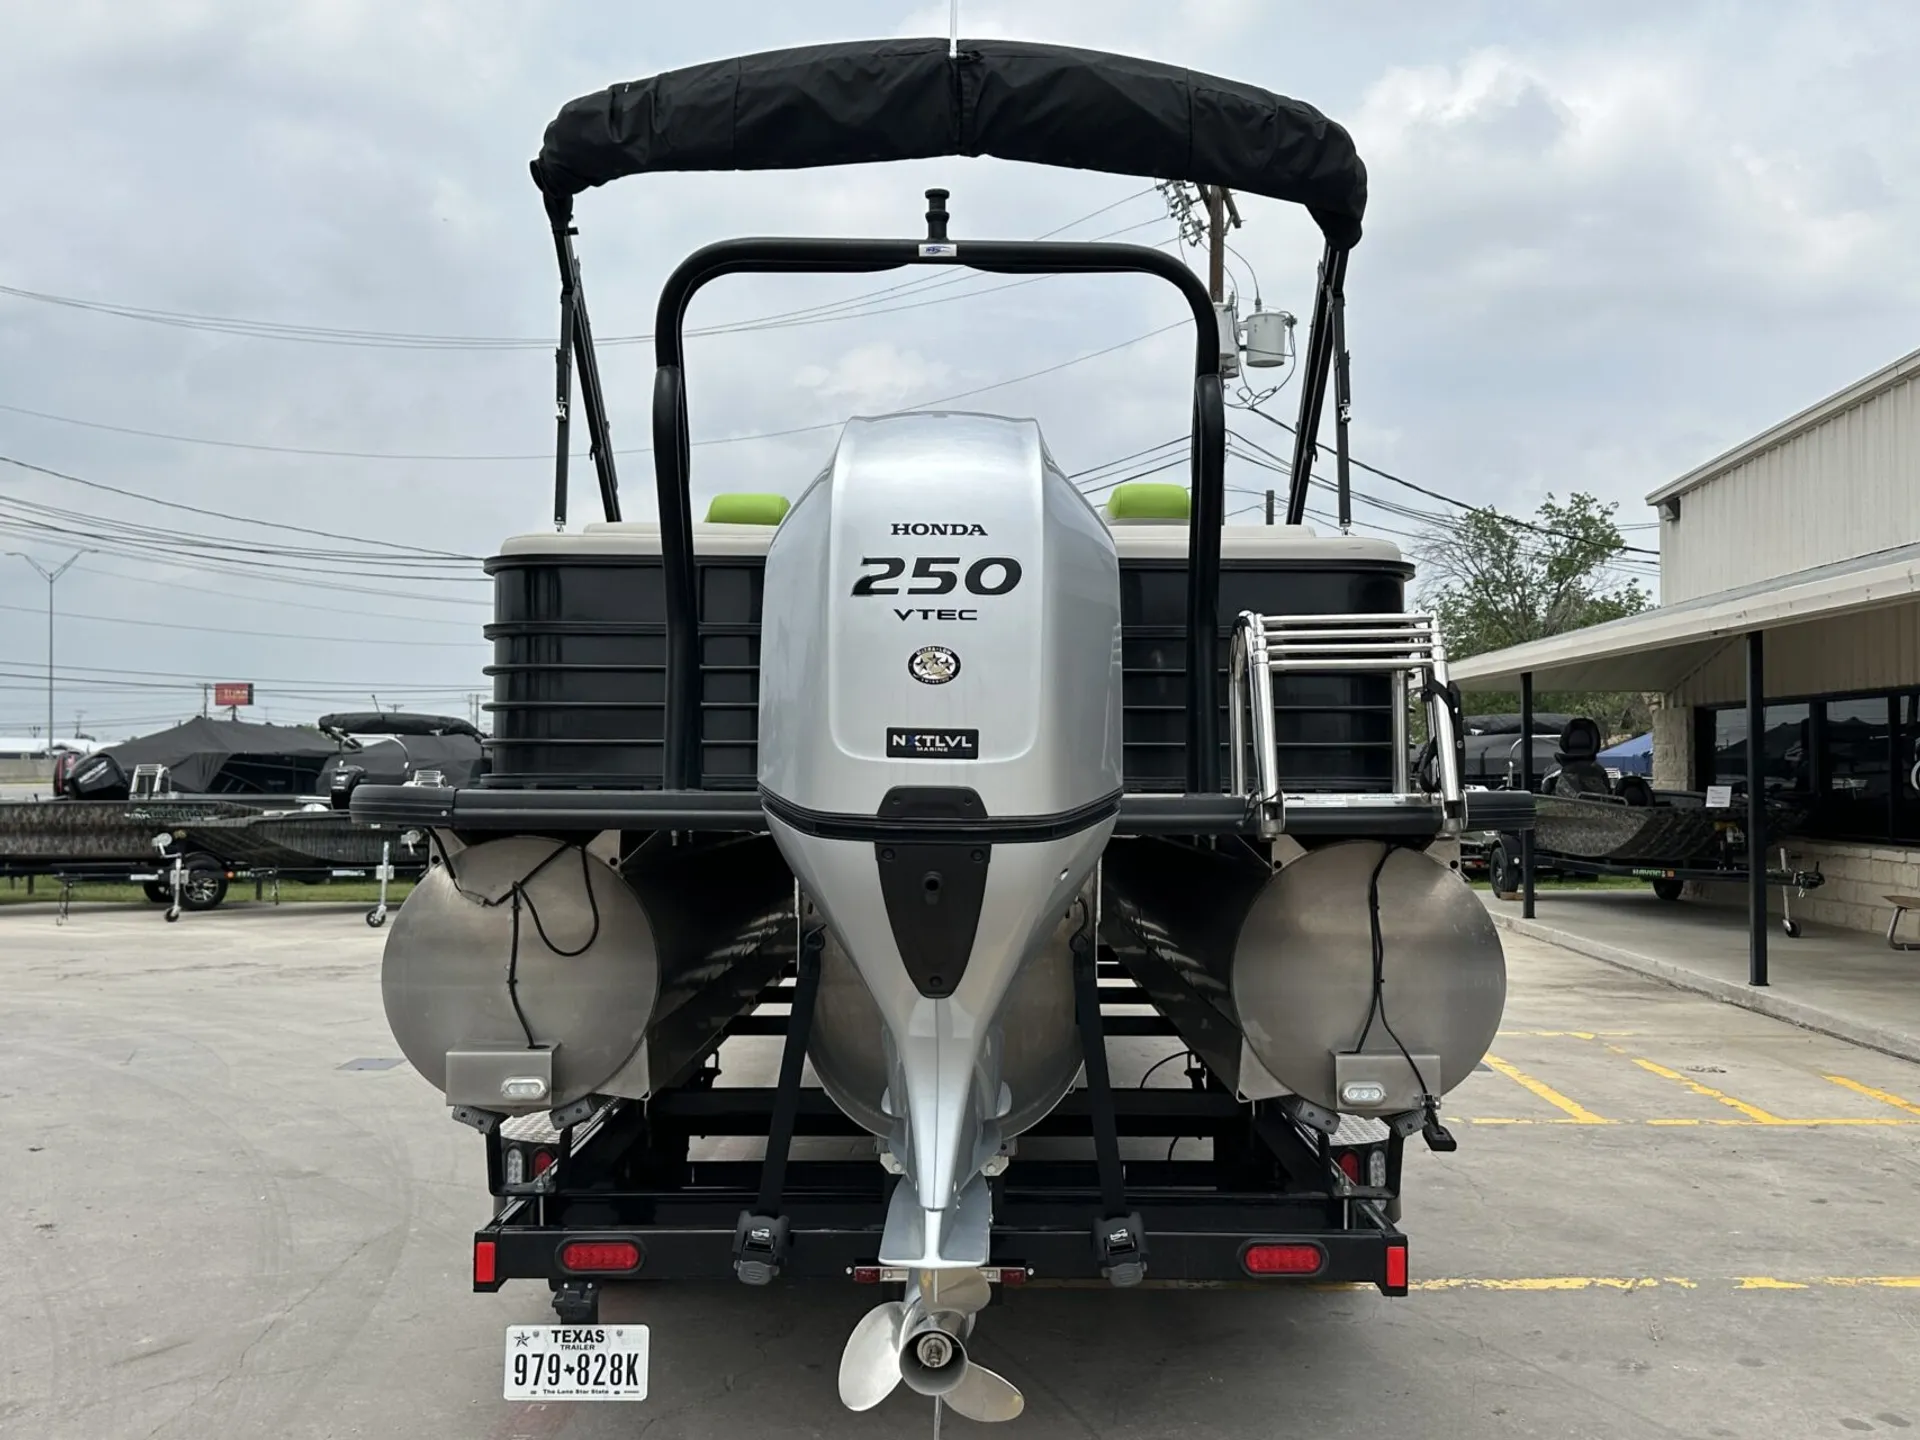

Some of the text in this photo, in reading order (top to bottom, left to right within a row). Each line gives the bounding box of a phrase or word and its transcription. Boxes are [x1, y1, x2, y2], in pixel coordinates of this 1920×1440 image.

[891, 523, 988, 536] HONDA
[851, 556, 1023, 597] 250
[893, 608, 978, 622] VTEC
[892, 734, 972, 748] NXTLVL
[551, 1330, 605, 1343] TEXAS
[514, 1353, 639, 1386] 979 828K
